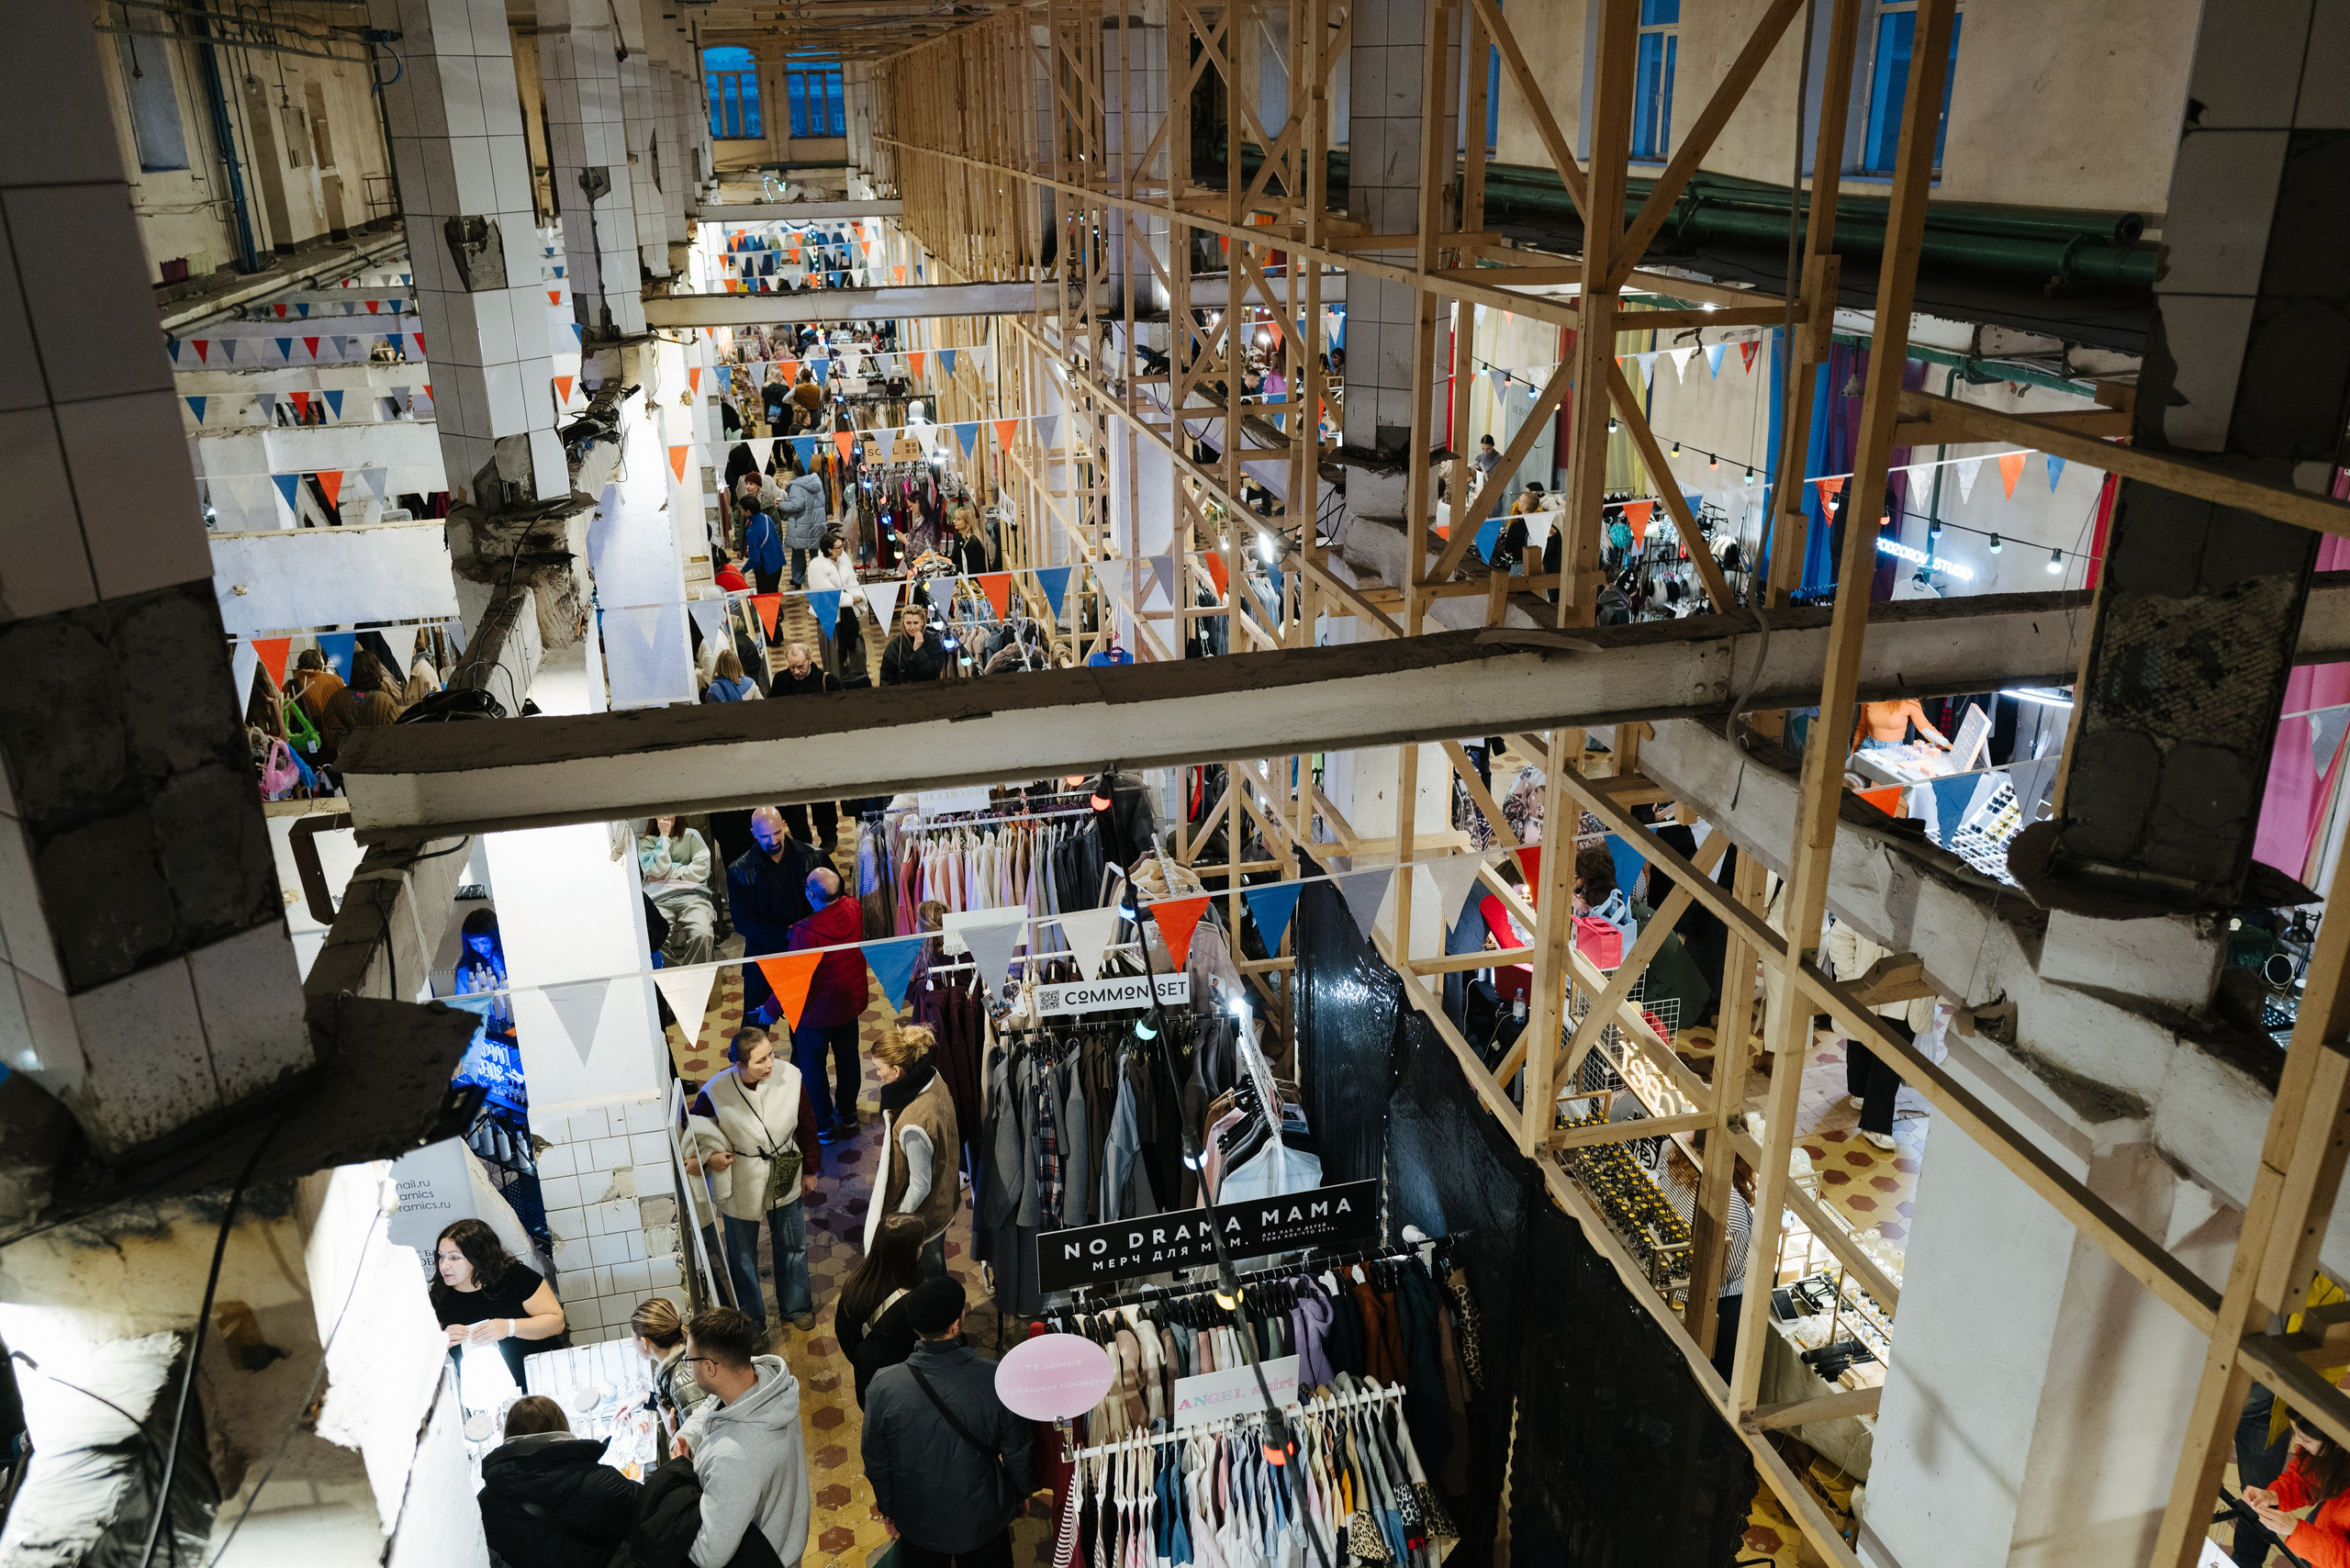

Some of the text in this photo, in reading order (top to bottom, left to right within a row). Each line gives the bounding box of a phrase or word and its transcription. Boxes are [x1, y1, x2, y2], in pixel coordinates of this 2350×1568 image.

[867, 447, 899, 457] SOL
[1931, 556, 1974, 580] STUDIO
[1065, 981, 1187, 1005] COMMON SET
[397, 1201, 451, 1213] ramics.ru
[1064, 1197, 1352, 1260] NO DRAMA MAMA
[1304, 1222, 1326, 1231] ДЕТЕЙ
[1092, 1237, 1248, 1271] МЕРЧ ДЛЯ ММ.
[1024, 1359, 1082, 1372] Те самые
[1177, 1387, 1246, 1410] ANGEL
